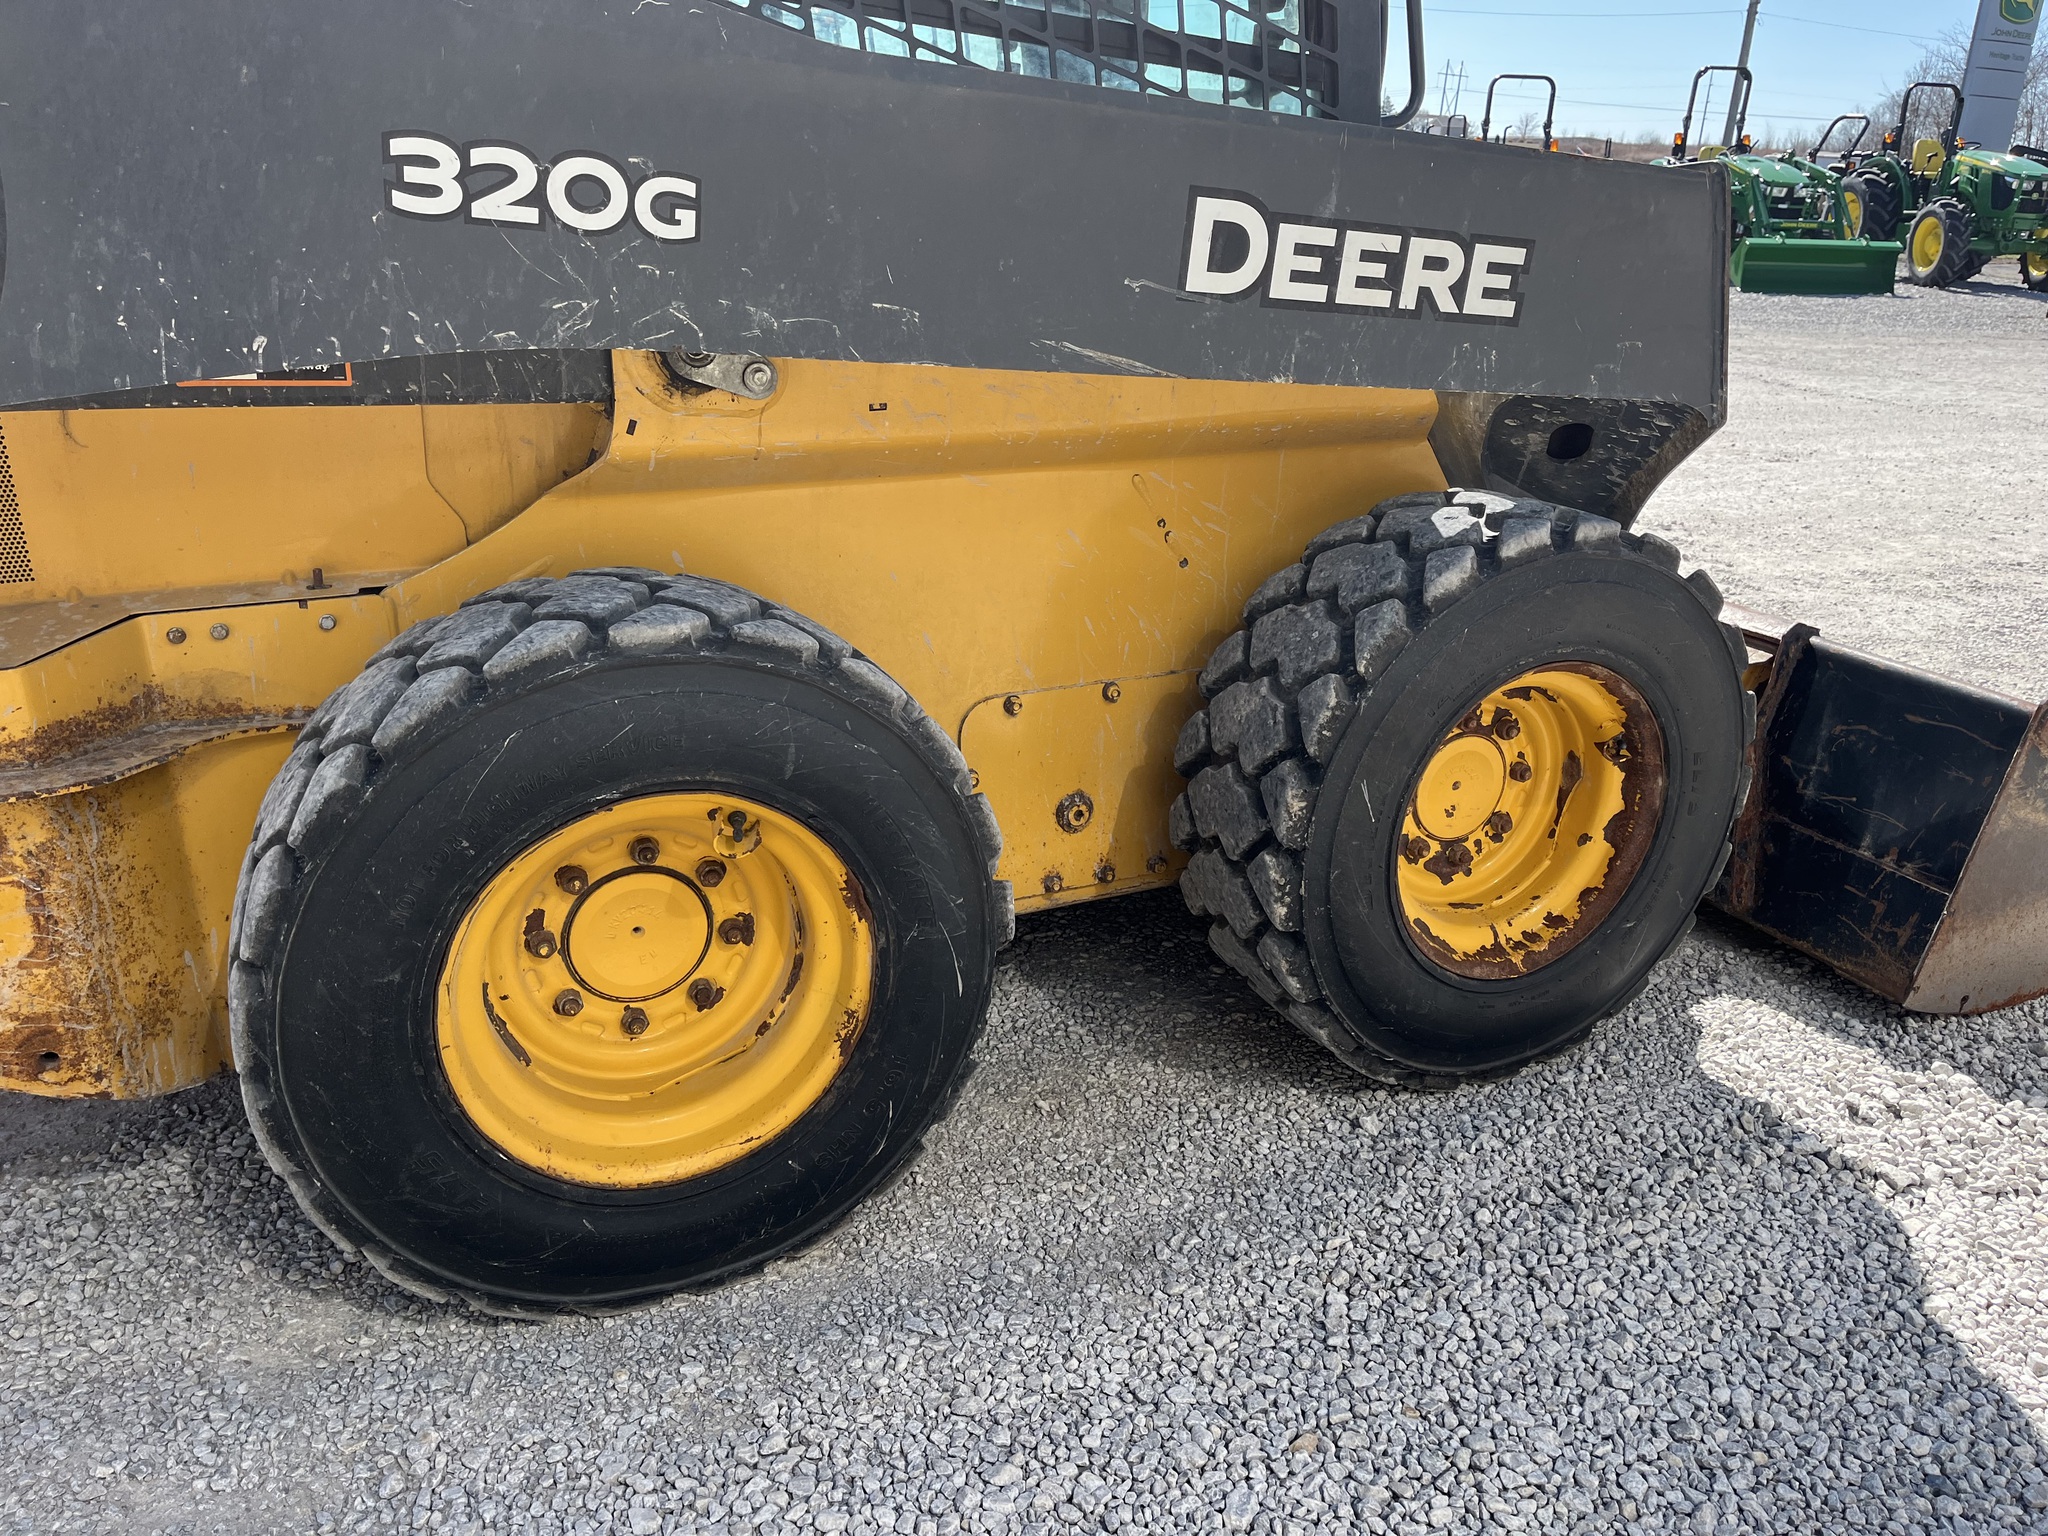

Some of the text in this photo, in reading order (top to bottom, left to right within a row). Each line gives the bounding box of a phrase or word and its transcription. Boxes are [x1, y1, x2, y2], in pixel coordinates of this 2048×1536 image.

[1991, 27, 2012, 37] JOHN
[389, 136, 697, 240] 320G
[1185, 196, 1527, 318] DEERE
[455, 759, 570, 838] HIGHWAY
[571, 735, 687, 770] SERVICE
